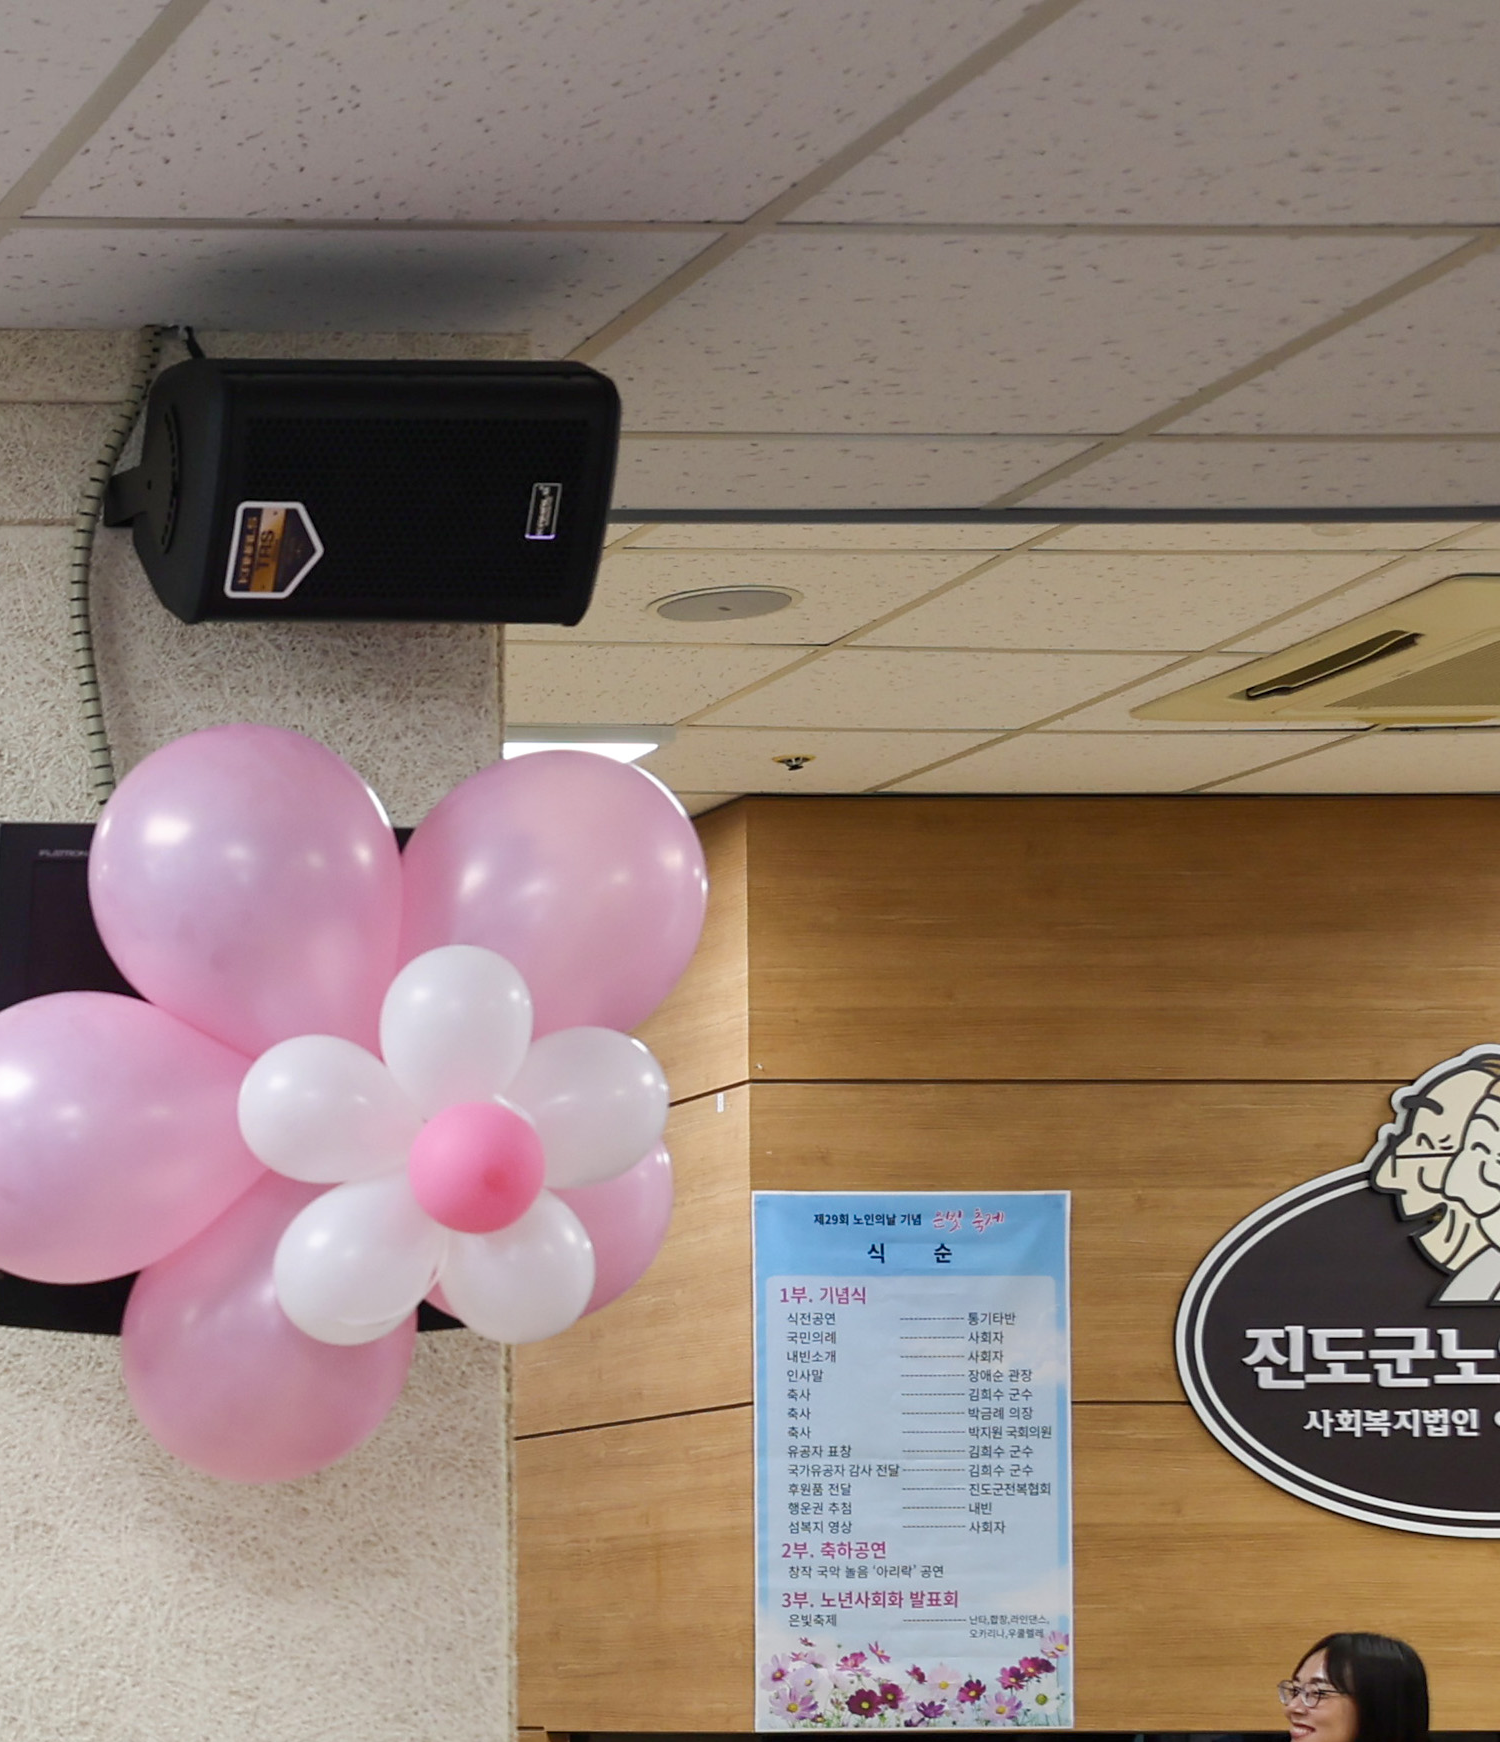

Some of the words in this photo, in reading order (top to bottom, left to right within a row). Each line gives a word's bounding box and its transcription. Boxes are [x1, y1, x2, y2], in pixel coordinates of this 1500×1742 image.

[814, 1213, 849, 1226] 제29회
[853, 1213, 896, 1226] 노인의날
[900, 1213, 922, 1226] 기념
[932, 1209, 964, 1232] 은빛
[972, 1208, 1004, 1233] 축제
[867, 1243, 885, 1263] 식
[934, 1243, 952, 1263] 순
[780, 1287, 813, 1305] 1부.
[820, 1286, 866, 1305] 기념식
[787, 1312, 836, 1326] 식전공연
[967, 1312, 1016, 1326] 통기타반
[787, 1331, 836, 1345] 국민의례
[968, 1331, 1004, 1344] 사회자
[787, 1350, 836, 1363] 내빈소개
[968, 1350, 1004, 1363] 사회자
[1242, 1325, 1500, 1390] 진도군노
[787, 1369, 824, 1382] 인사말
[968, 1369, 1004, 1382] 장애순
[1008, 1369, 1033, 1382] 관장
[787, 1388, 811, 1401] 축사
[1009, 1388, 1033, 1401] 군수
[787, 1407, 811, 1420] 축사
[1009, 1407, 1033, 1420] 의장
[1304, 1408, 1480, 1438] 사회복지법인
[788, 1426, 811, 1439] 축사
[968, 1426, 1003, 1439] 박지원
[1005, 1426, 1052, 1439] 국회의원
[788, 1445, 823, 1458] 유공자
[827, 1445, 852, 1458] 표창
[1009, 1445, 1034, 1458] 군수
[788, 1464, 846, 1477] 국가유공자
[849, 1464, 873, 1477] 감사
[876, 1464, 900, 1477] 전달
[1009, 1464, 1034, 1477] 군수
[788, 1483, 824, 1496] 후원품
[828, 1483, 852, 1496] 전달
[969, 1483, 1051, 1496] 진도군전복협회
[788, 1502, 823, 1515] 행운권
[828, 1502, 852, 1515] 추첨
[969, 1502, 992, 1515] 내빈
[788, 1521, 824, 1534] 섬복지
[828, 1521, 852, 1534] 영상
[969, 1521, 1006, 1534] 사회자
[781, 1542, 814, 1559] 2부.
[820, 1541, 887, 1560] 축하공연
[788, 1566, 812, 1579] 창작
[817, 1566, 840, 1578] 국악
[920, 1566, 944, 1578] 공연
[781, 1591, 815, 1608] 3부.
[820, 1590, 904, 1609] 노년사회화
[910, 1590, 959, 1609] 발표회
[788, 1614, 837, 1627] 은빛축제
